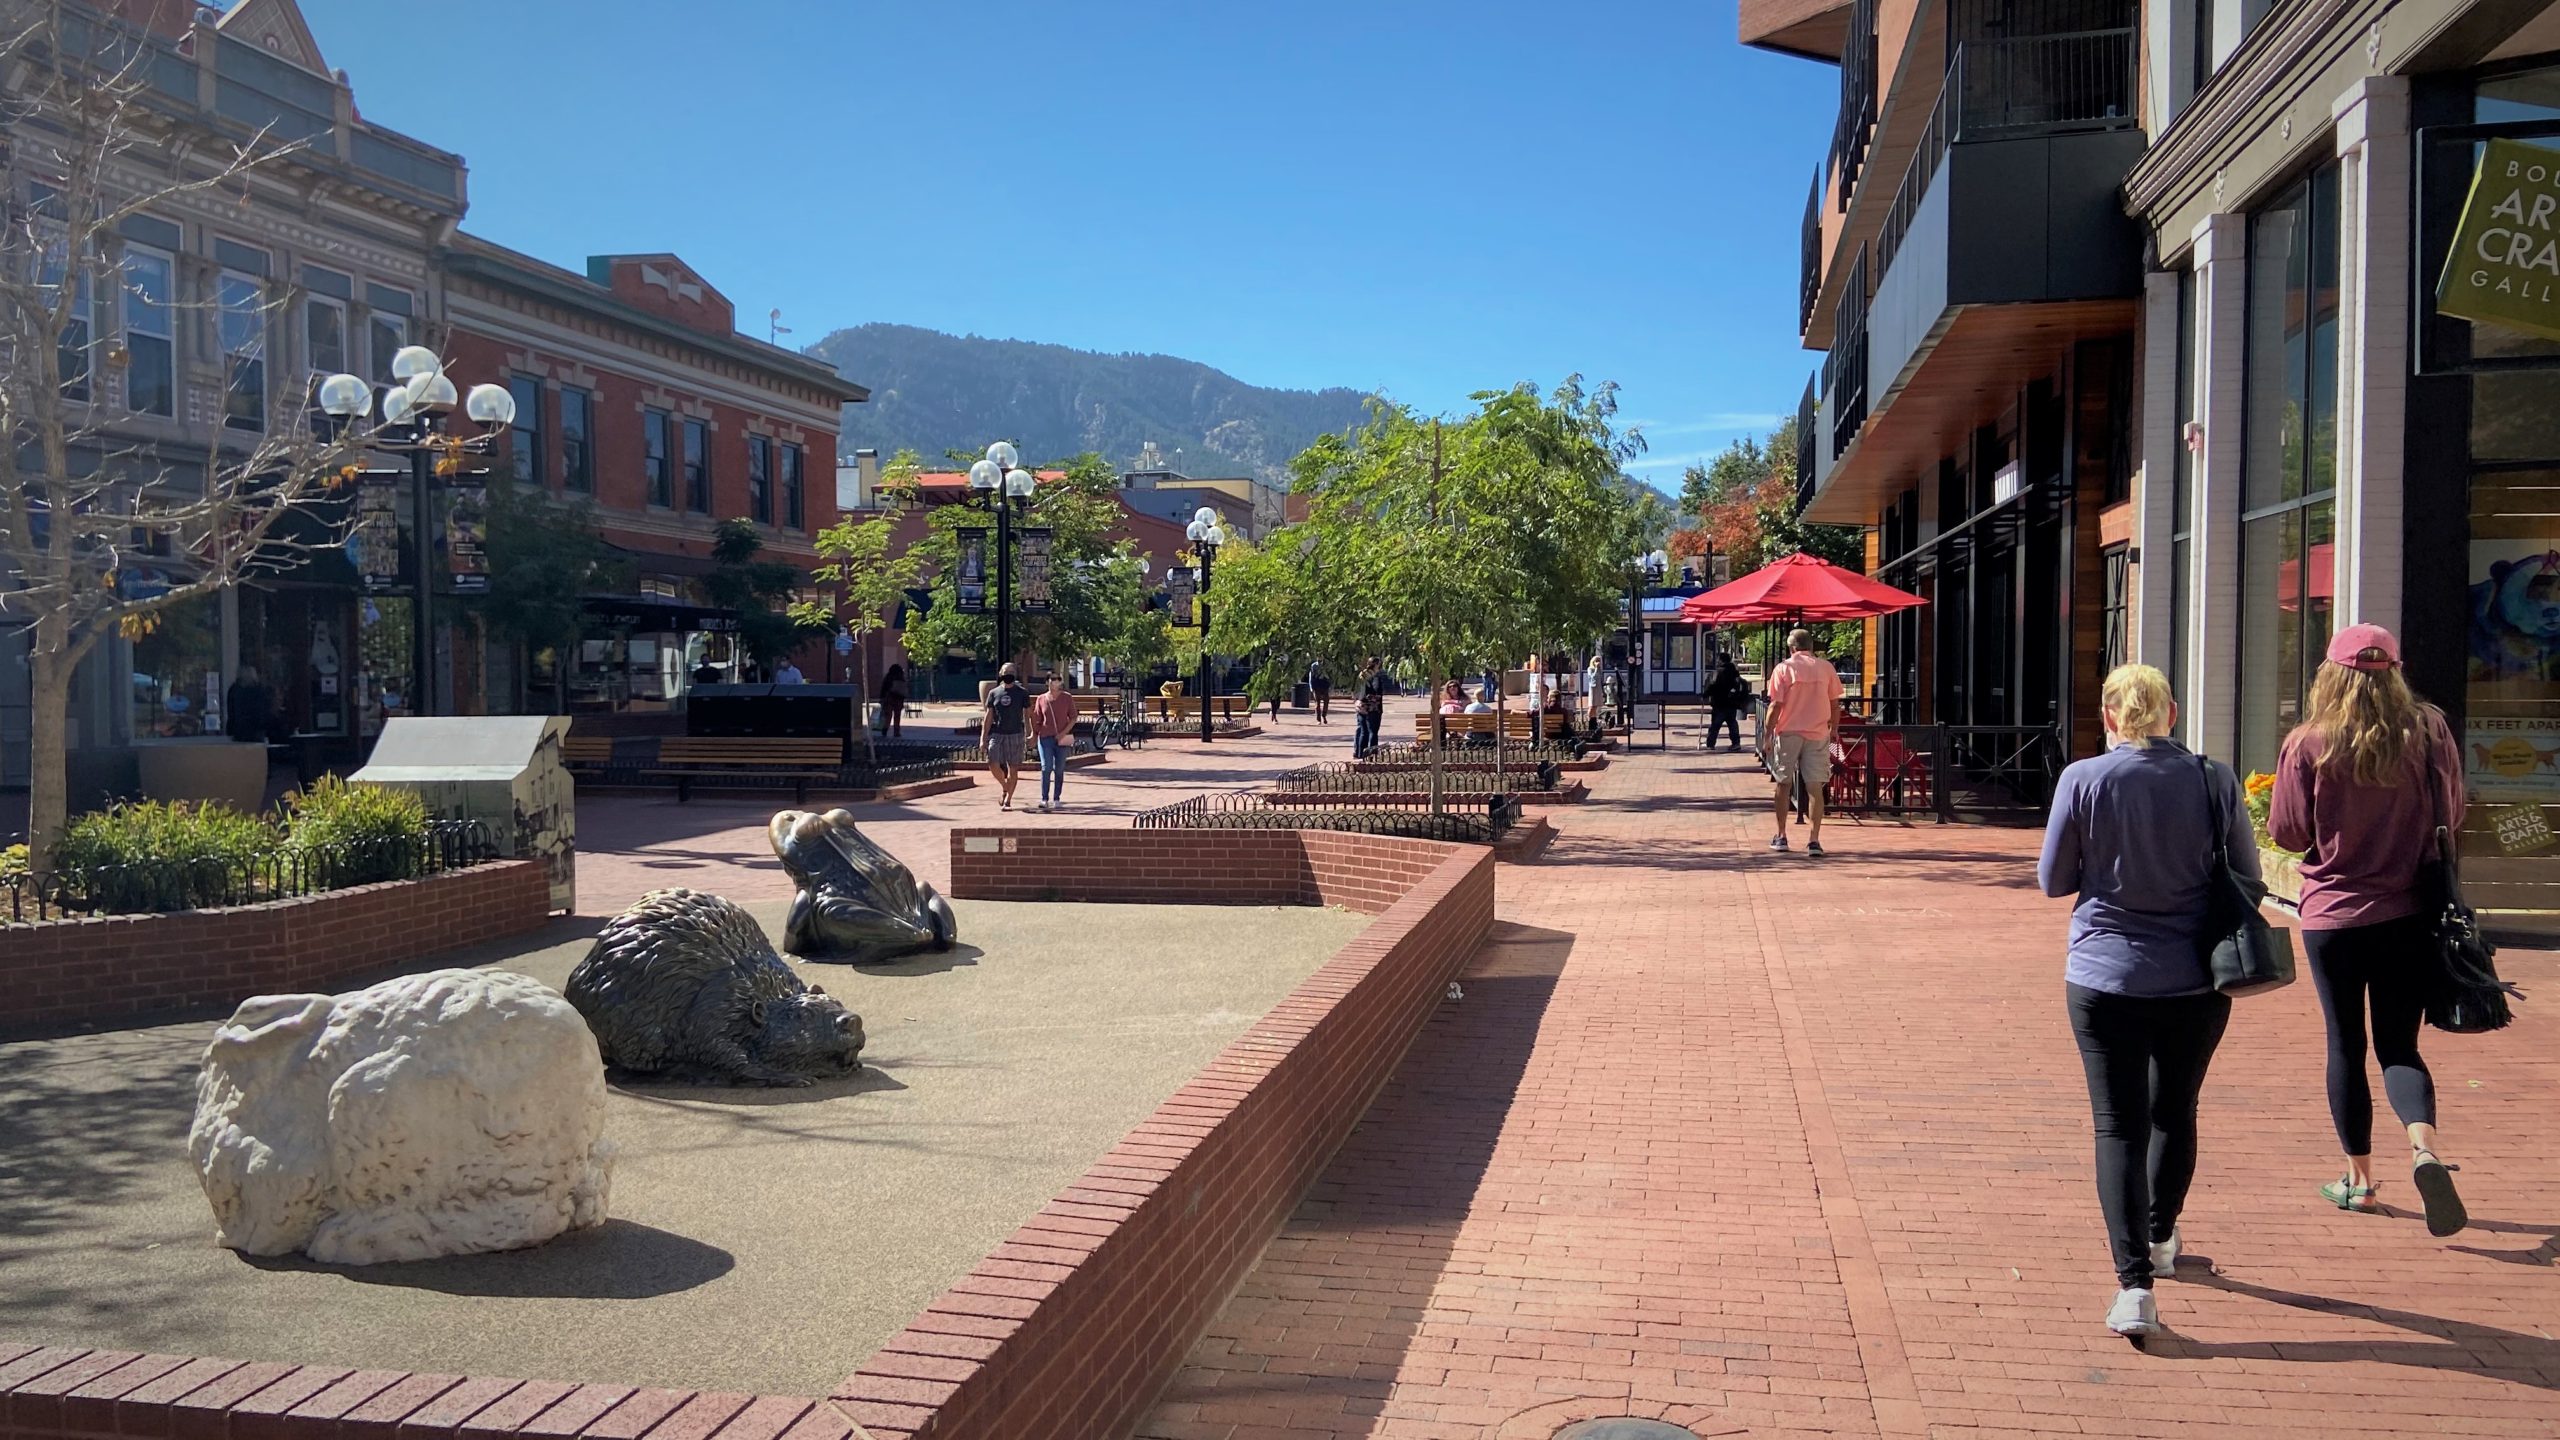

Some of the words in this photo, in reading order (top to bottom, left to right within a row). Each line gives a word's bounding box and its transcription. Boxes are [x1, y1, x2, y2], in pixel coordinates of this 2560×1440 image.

[2490, 188, 2560, 231] AR
[2476, 228, 2560, 276] CRA
[2470, 270, 2551, 302] GALL
[2465, 720, 2482, 730] IX
[2487, 720, 2522, 730] FEET
[2491, 804, 2536, 822] BOULDER
[2496, 815, 2529, 834] ARTS
[2500, 822, 2548, 844] CRAFTS
[2505, 833, 2550, 852] GALLERY
